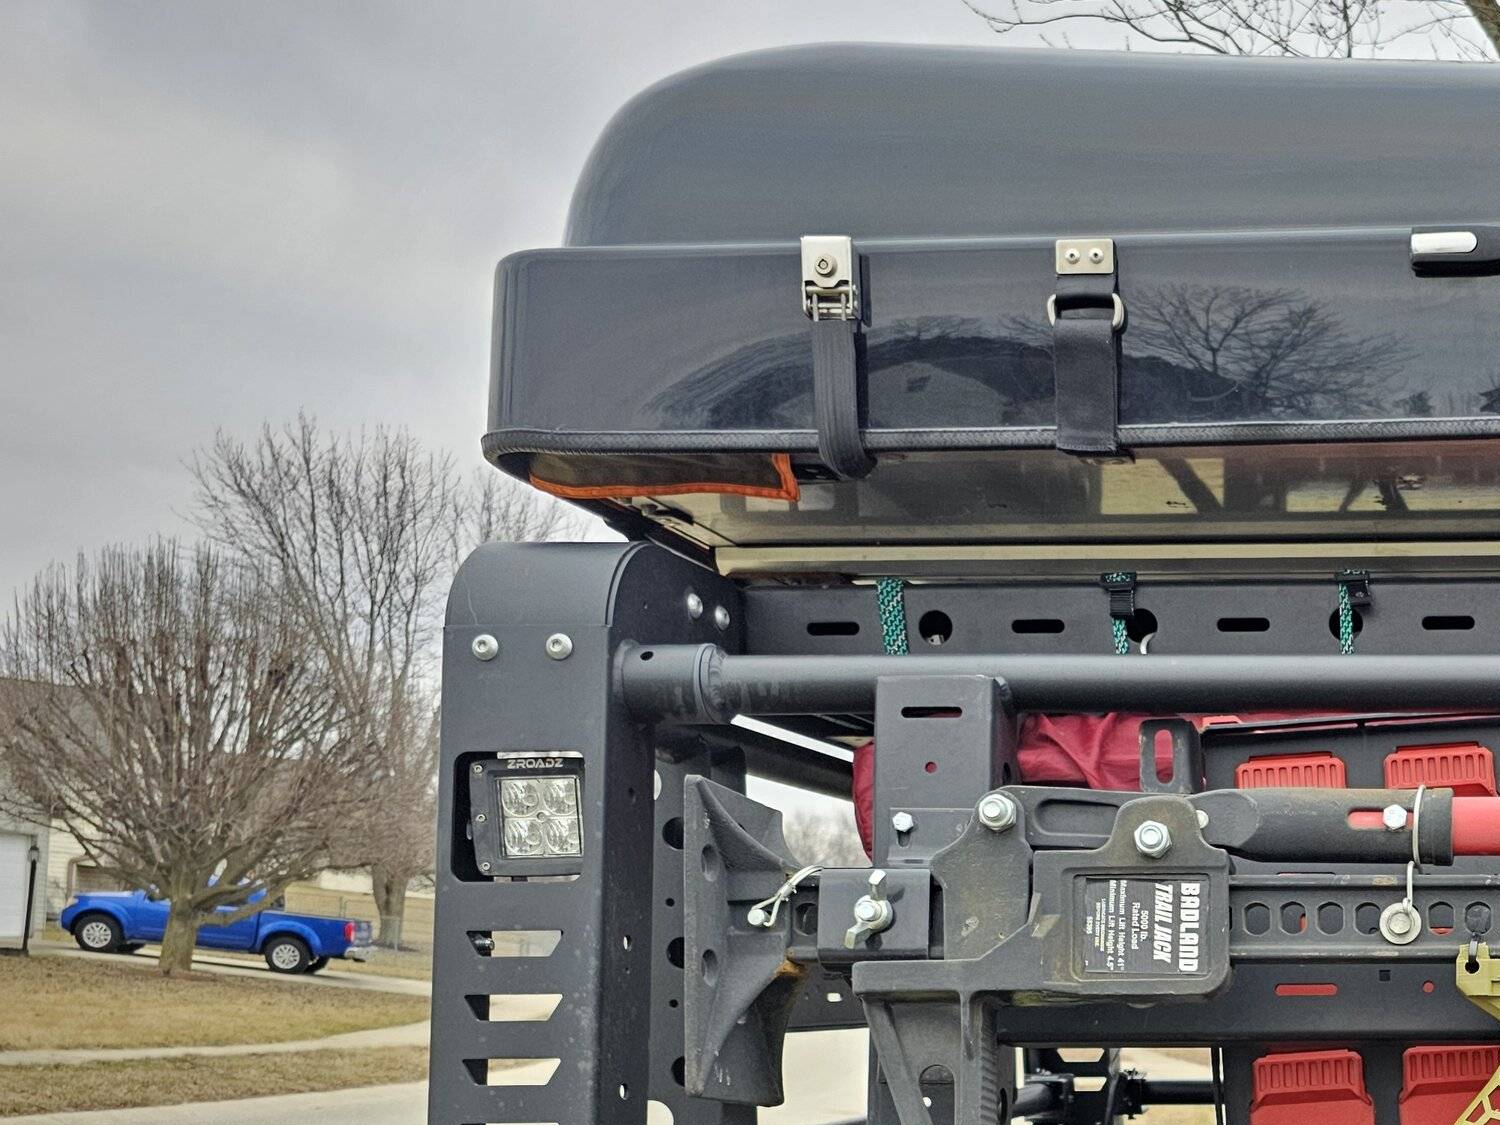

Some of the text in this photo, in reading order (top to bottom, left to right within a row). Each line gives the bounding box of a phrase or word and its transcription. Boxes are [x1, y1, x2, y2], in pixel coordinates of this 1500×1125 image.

[506, 758, 564, 769] ZROADZ
[1109, 880, 1117, 913] Minimum
[1119, 880, 1127, 915] Maximum
[1108, 915, 1116, 928] Lift
[1119, 917, 1127, 930] Lift
[1131, 902, 1141, 950] Rated Load
[1140, 910, 1149, 930] 5000
[1153, 882, 1174, 964] TRAIL JACK
[1179, 882, 1200, 972] BADLAND
[1106, 930, 1115, 954] Height
[1117, 931, 1126, 956] Height
